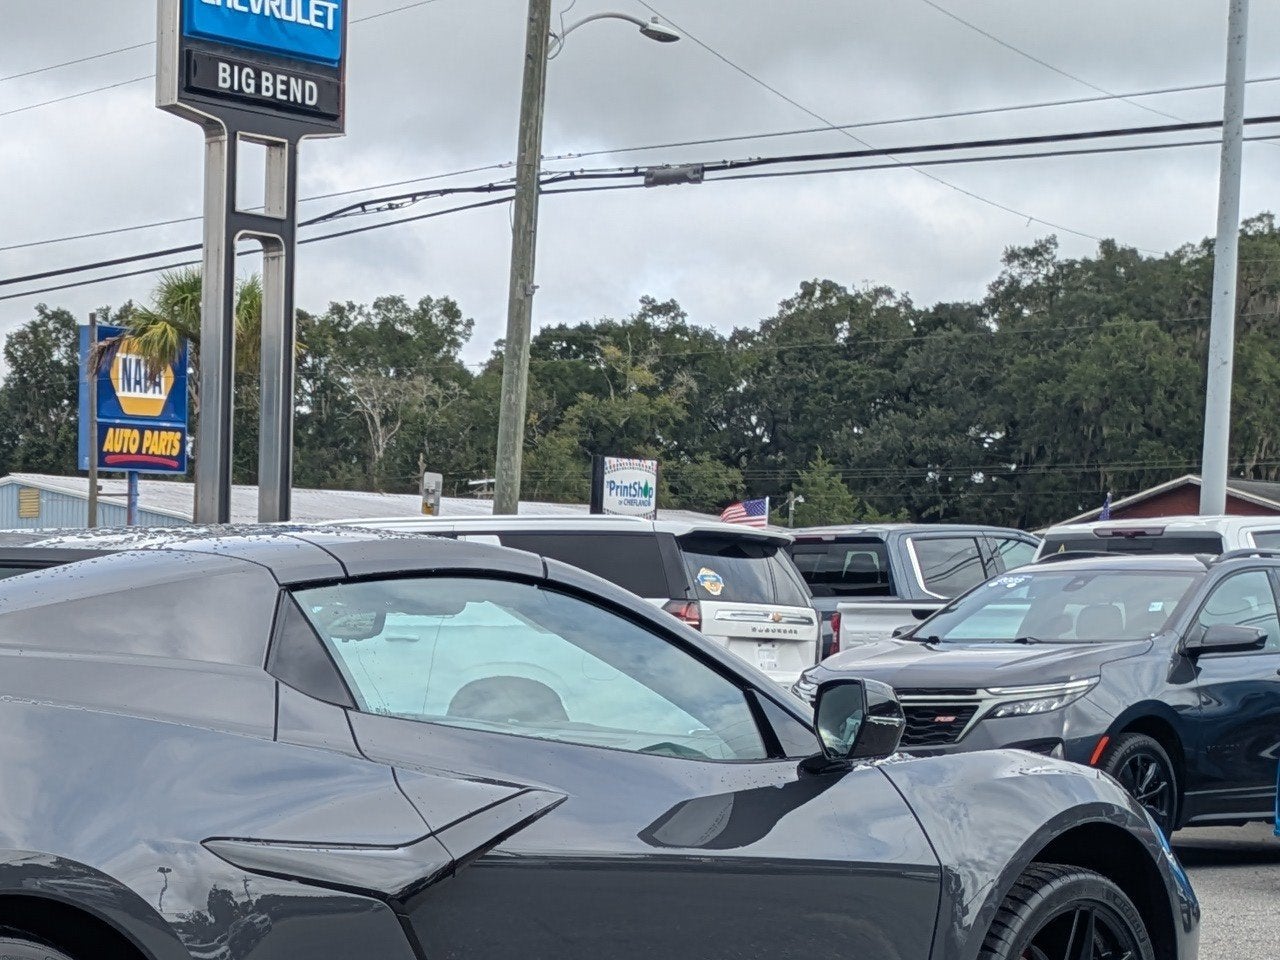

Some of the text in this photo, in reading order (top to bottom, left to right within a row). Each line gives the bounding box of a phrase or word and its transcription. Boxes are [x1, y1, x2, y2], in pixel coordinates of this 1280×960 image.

[201, 0, 338, 31] VROLET
[218, 62, 318, 106] BIG BEND
[103, 427, 181, 456] AUTO PARTS
